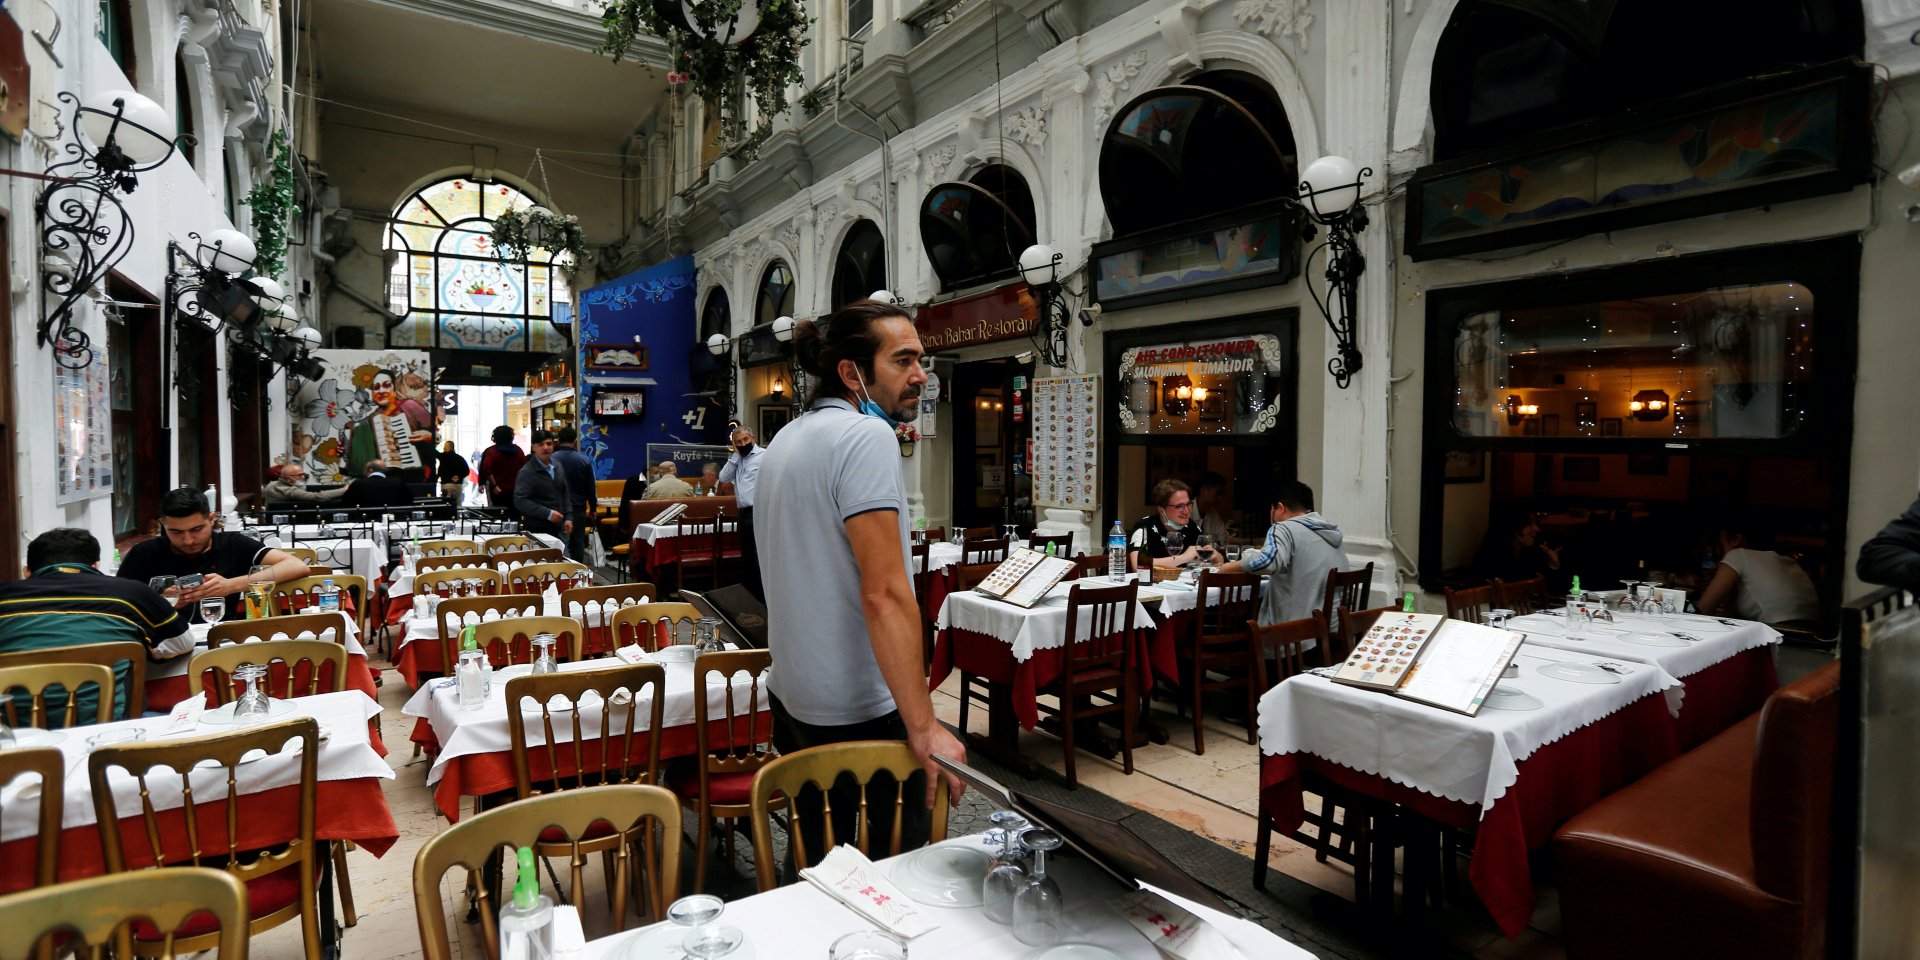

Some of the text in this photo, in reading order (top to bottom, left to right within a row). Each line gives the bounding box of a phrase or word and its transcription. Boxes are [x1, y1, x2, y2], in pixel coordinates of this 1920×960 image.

[944, 326, 976, 346] Bahar
[977, 317, 1033, 340] Restoran
[1135, 339, 1255, 363] AIR CONDITIONER
[1133, 364, 1188, 379] SALONUMUZ
[682, 406, 706, 430] +1
[673, 450, 702, 462] Keyfe
